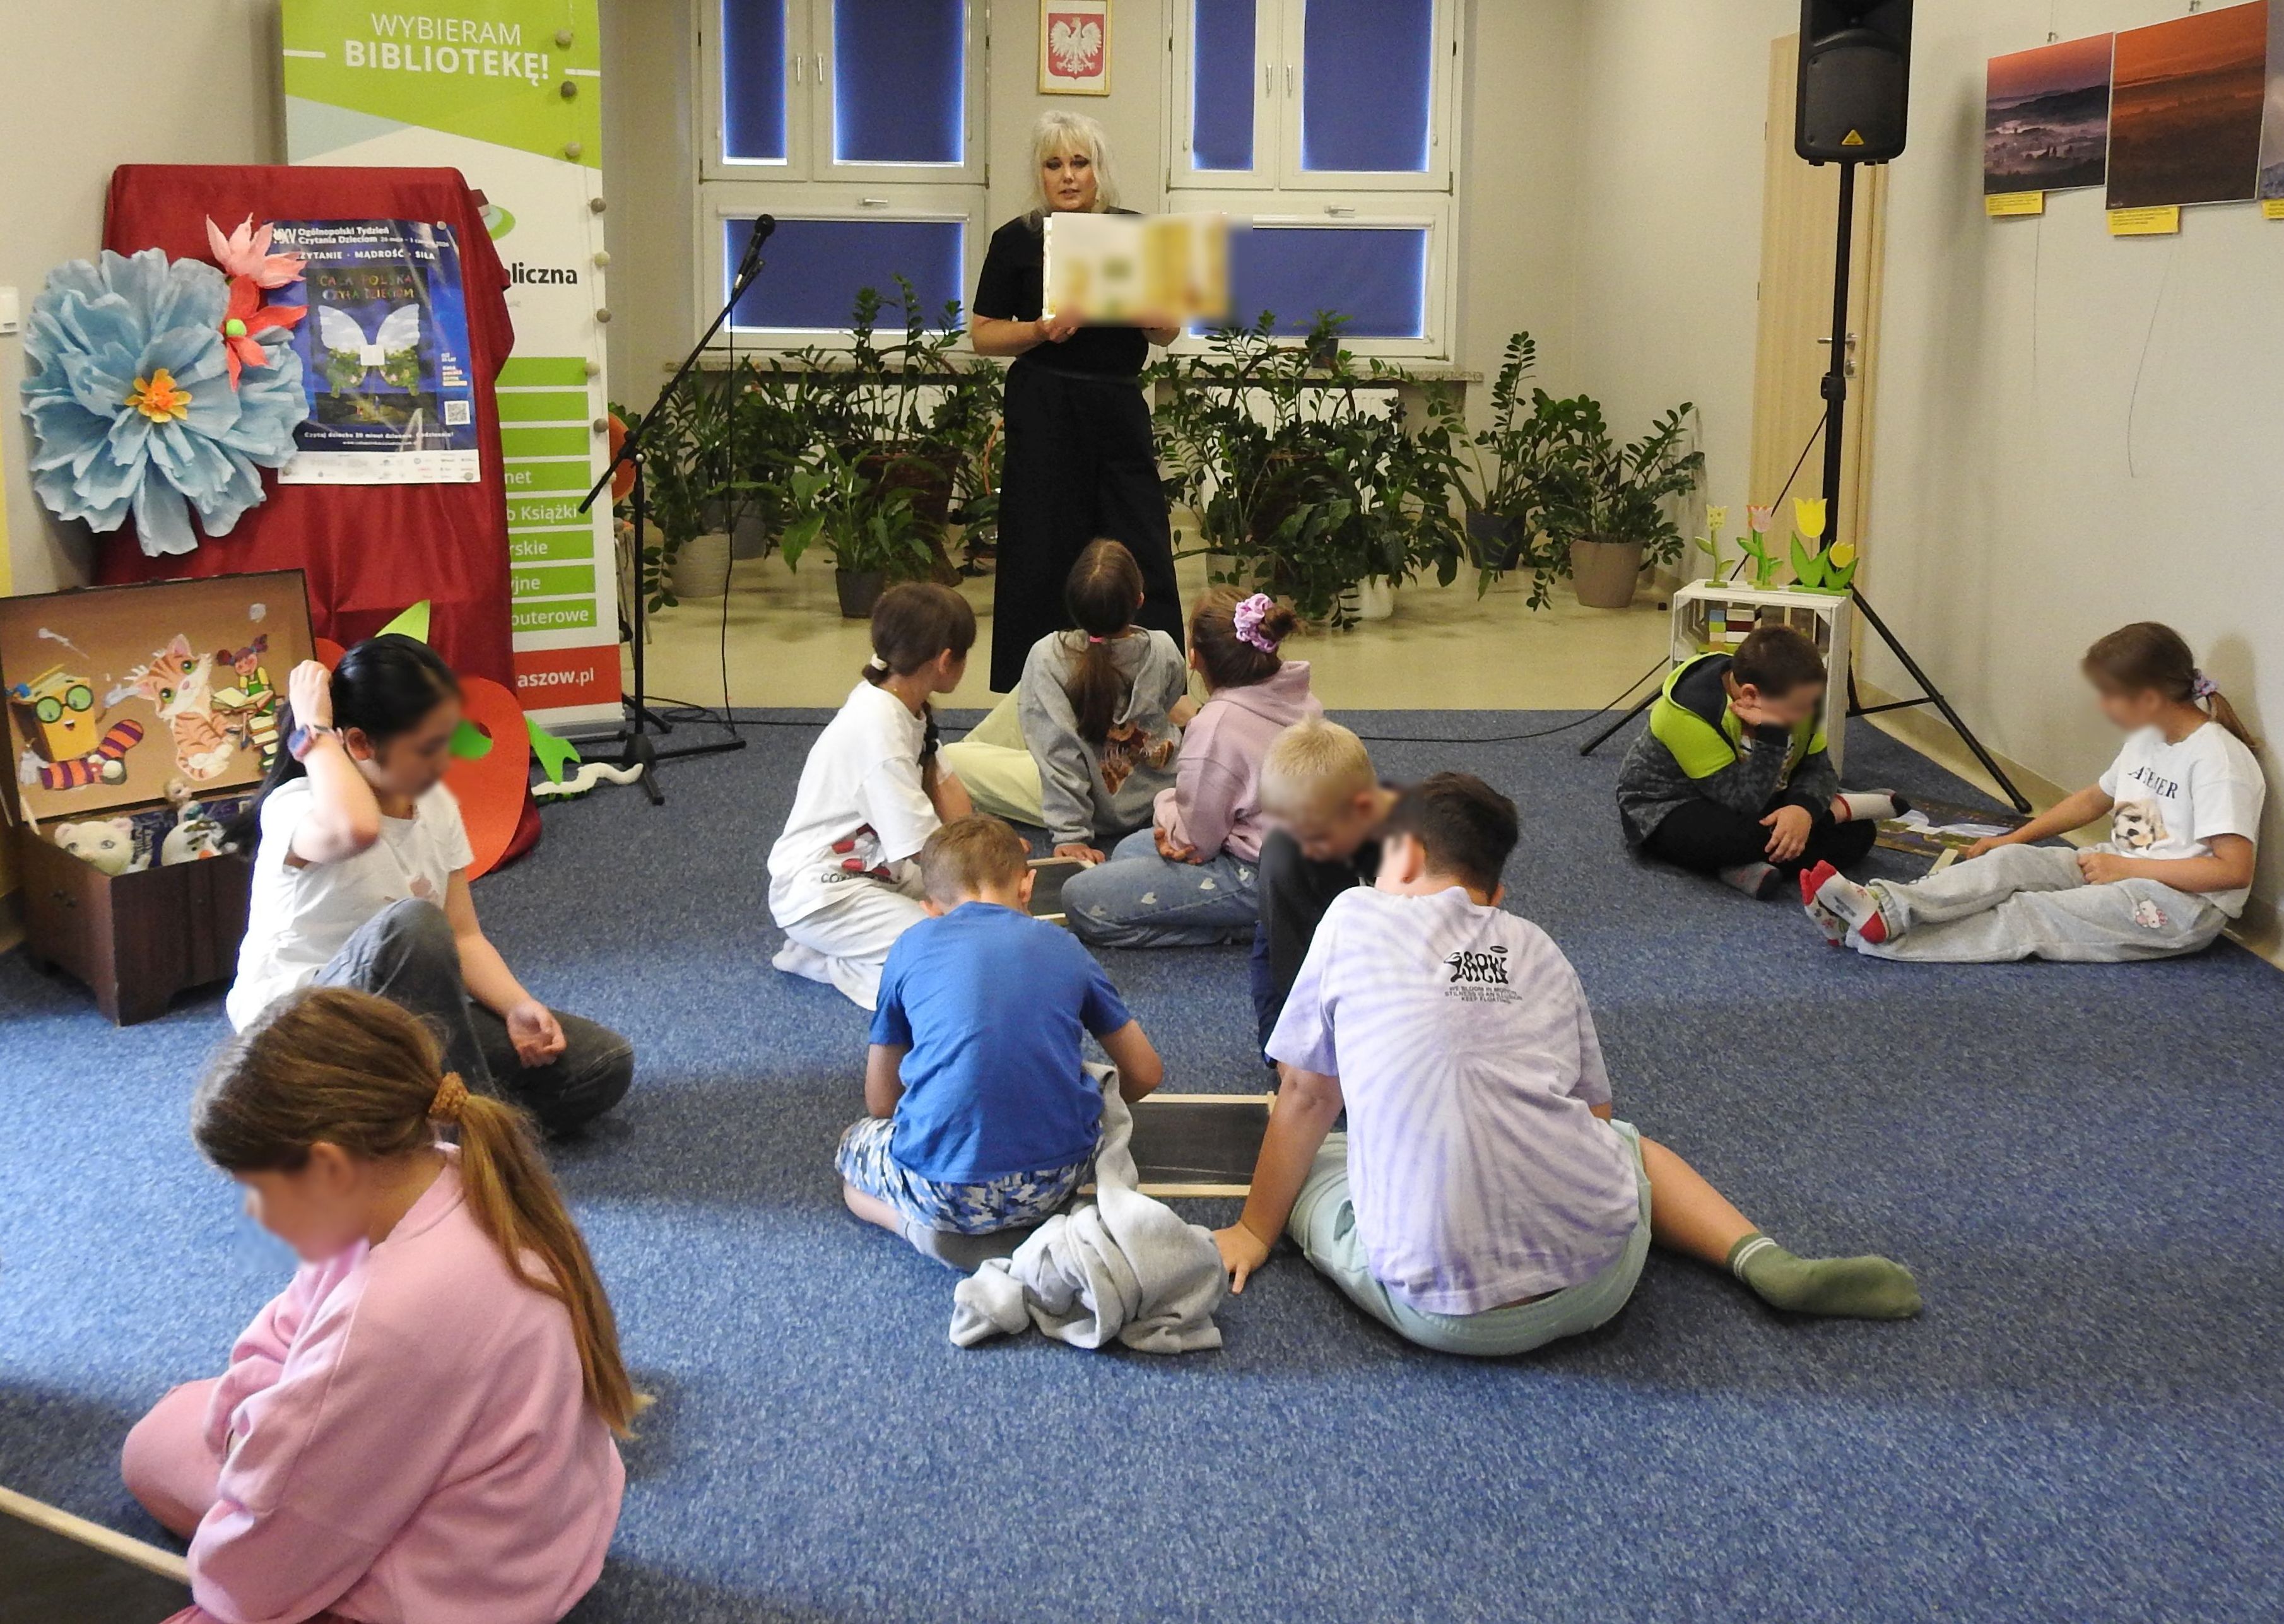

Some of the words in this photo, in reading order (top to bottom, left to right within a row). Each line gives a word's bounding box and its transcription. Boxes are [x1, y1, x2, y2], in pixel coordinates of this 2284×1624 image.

[372, 13, 521, 46] WYBIERAM
[345, 40, 549, 86] BIBLIOTEKĘ!
[298, 227, 355, 237] Ogólnopolski
[356, 227, 389, 236] Tydzień
[298, 237, 336, 245] Czytania
[355, 247, 404, 259] MĄDROŚĆ
[415, 251, 435, 260] SIŁA
[505, 262, 578, 285] liczna
[521, 504, 577, 524] Książki
